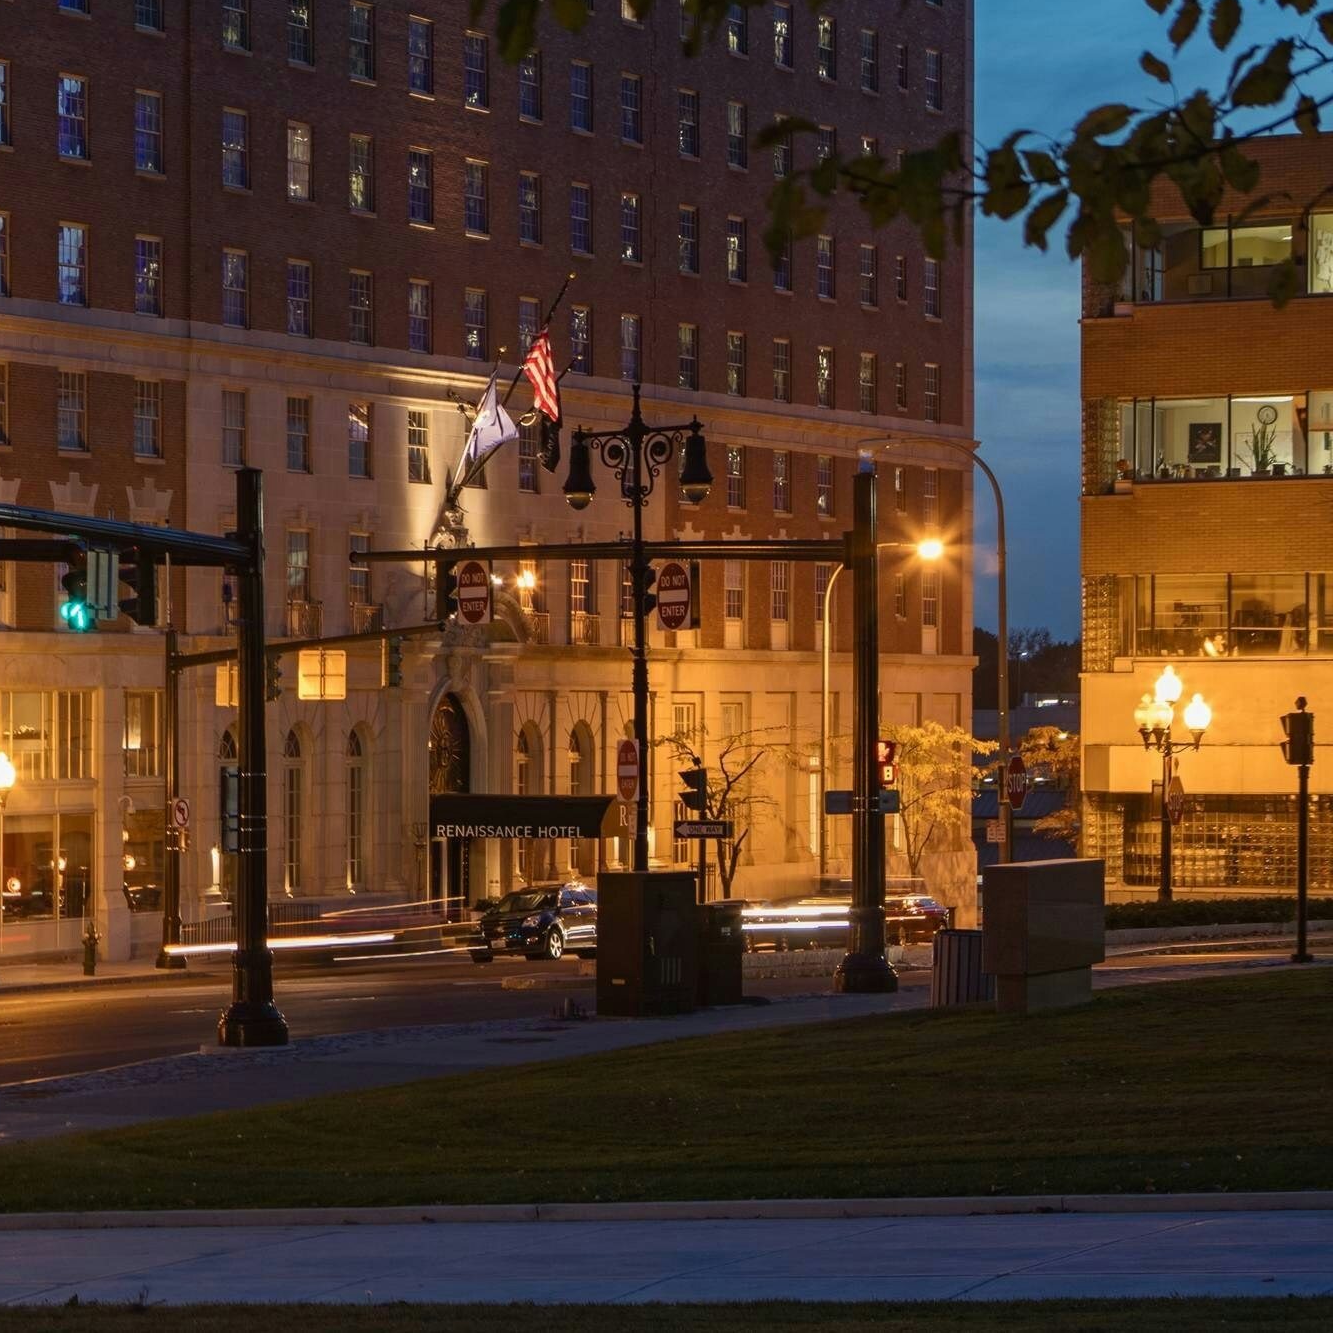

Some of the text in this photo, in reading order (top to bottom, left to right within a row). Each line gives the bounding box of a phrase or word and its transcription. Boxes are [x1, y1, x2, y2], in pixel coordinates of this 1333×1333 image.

[461, 572, 486, 585] DO NOT
[660, 575, 686, 587] DO NOT
[462, 601, 487, 613] ENTER
[661, 605, 686, 618] ENTER
[1008, 772, 1026, 794] STOP
[436, 825, 585, 839] RENAISSANCE HOTEL
